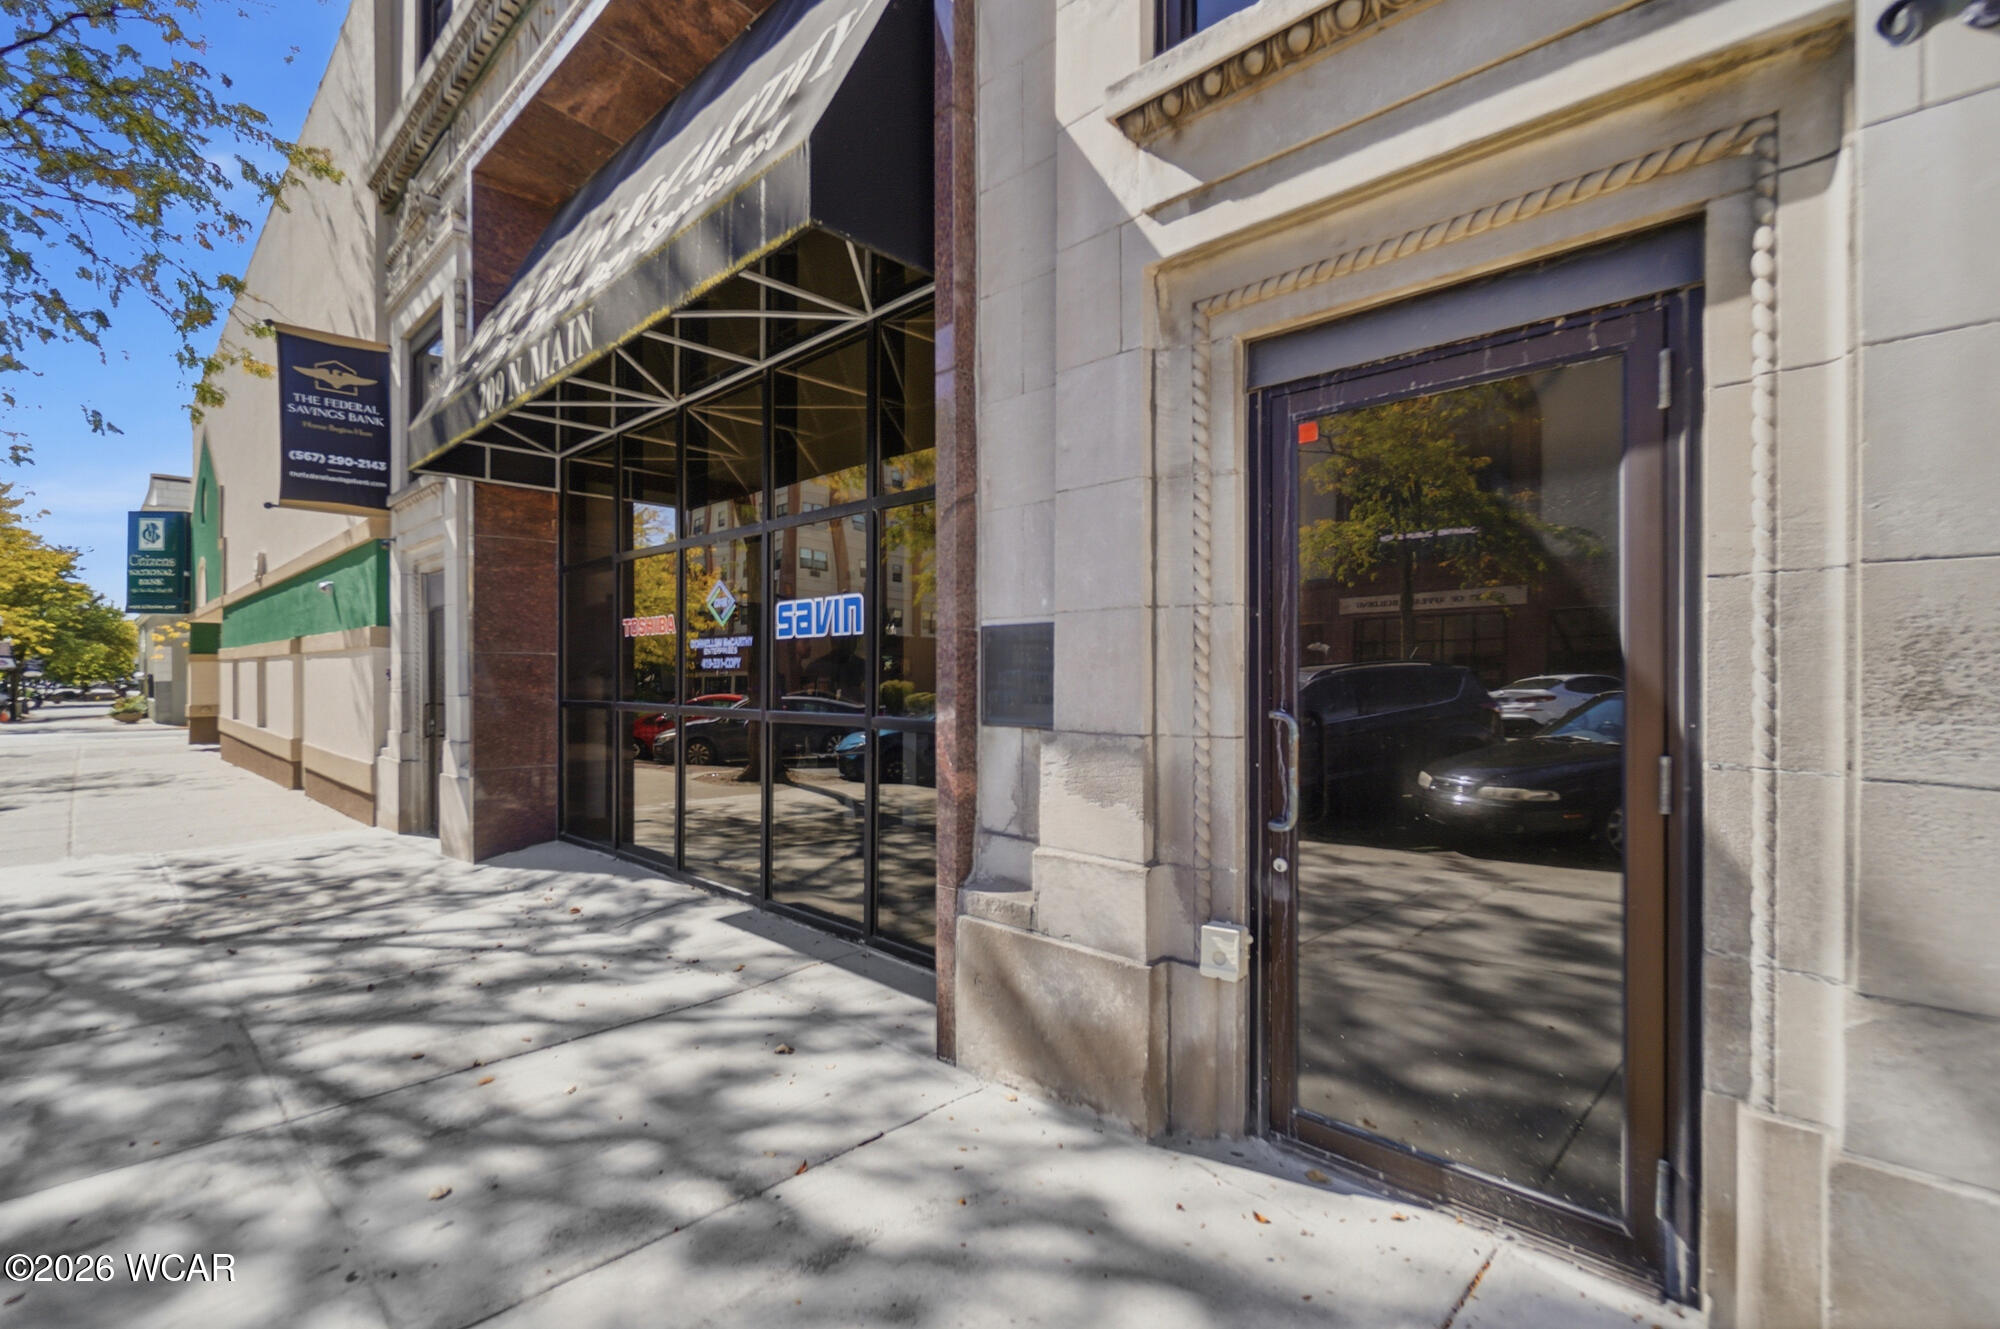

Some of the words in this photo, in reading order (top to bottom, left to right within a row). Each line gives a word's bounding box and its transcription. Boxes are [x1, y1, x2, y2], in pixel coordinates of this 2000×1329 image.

[478, 370, 505, 419] 209
[508, 357, 526, 401] N.
[530, 304, 594, 387] MAIN
[292, 392, 322, 406] THE
[323, 397, 380, 415] FEDERAL
[287, 403, 346, 420] SAVINGS
[347, 412, 385, 428] BANK
[288, 450, 326, 464] (567)
[327, 454, 388, 471] 290-2143
[129, 554, 177, 568] Citizens
[622, 614, 677, 638] TOSHIBA
